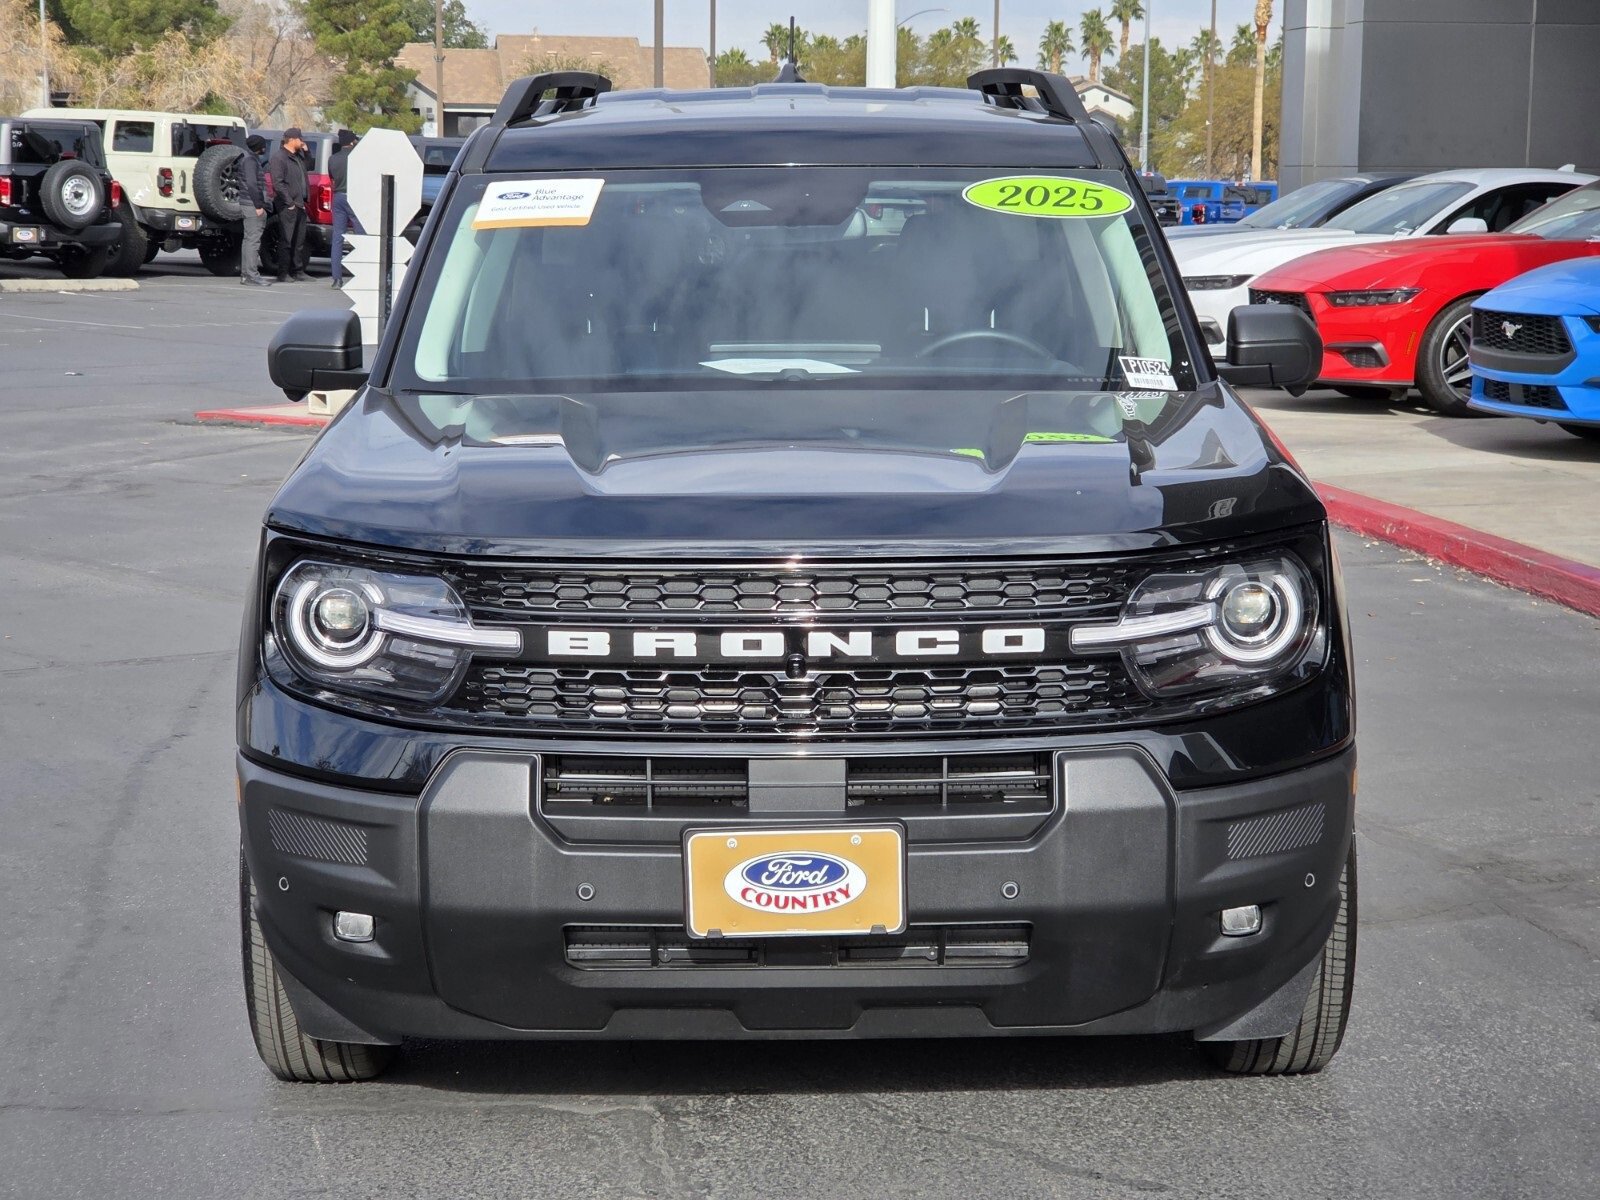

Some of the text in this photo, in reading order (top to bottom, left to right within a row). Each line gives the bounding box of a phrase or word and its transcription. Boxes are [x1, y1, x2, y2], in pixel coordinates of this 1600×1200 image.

[532, 194, 584, 202] Advantage
[997, 185, 1103, 211] 2025
[1129, 359, 1170, 376] P10524
[548, 628, 1045, 657] BRONCO
[761, 858, 828, 885] Ford
[740, 883, 851, 910] COUNTRY
